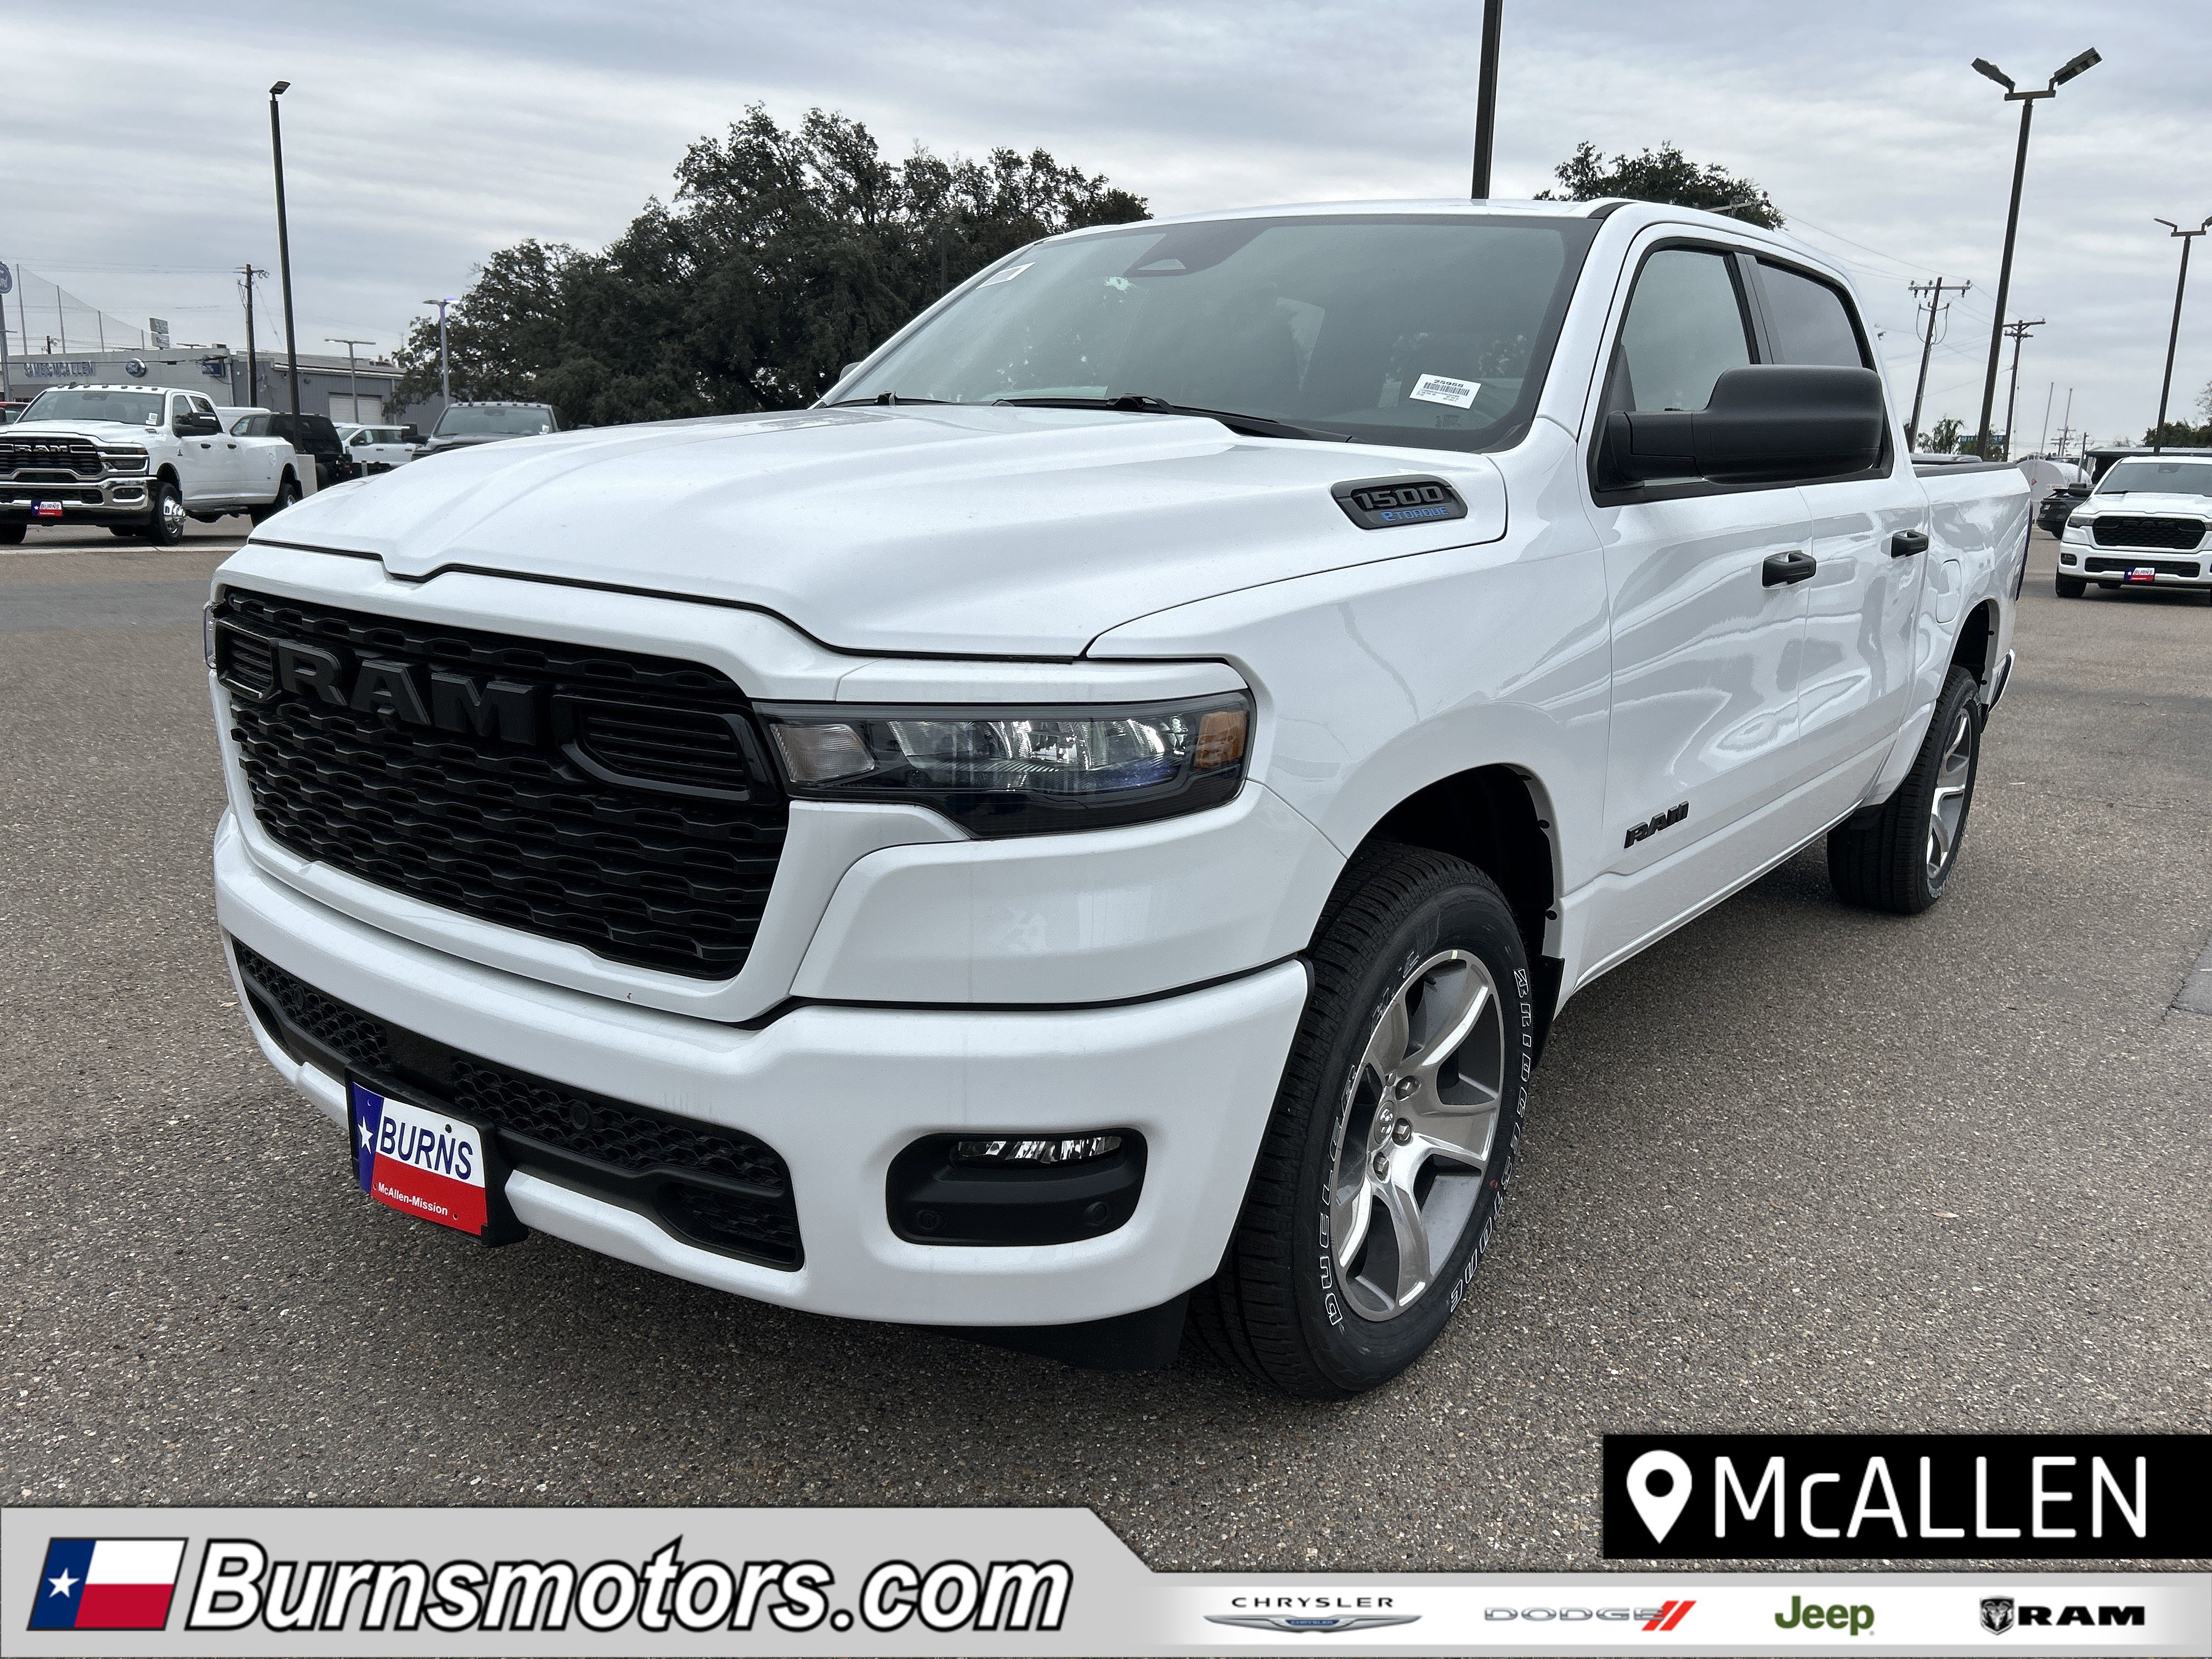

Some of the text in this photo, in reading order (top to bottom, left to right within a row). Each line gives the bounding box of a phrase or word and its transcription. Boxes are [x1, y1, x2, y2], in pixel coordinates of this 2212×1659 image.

[1353, 486, 1445, 509] 1500
[278, 641, 536, 746] RAM
[1624, 800, 1689, 849] RAM
[380, 1116, 473, 1180] BURNS
[1451, 968, 1532, 1313] BRIDGESTONE
[378, 1182, 448, 1216] McAllen-Mission
